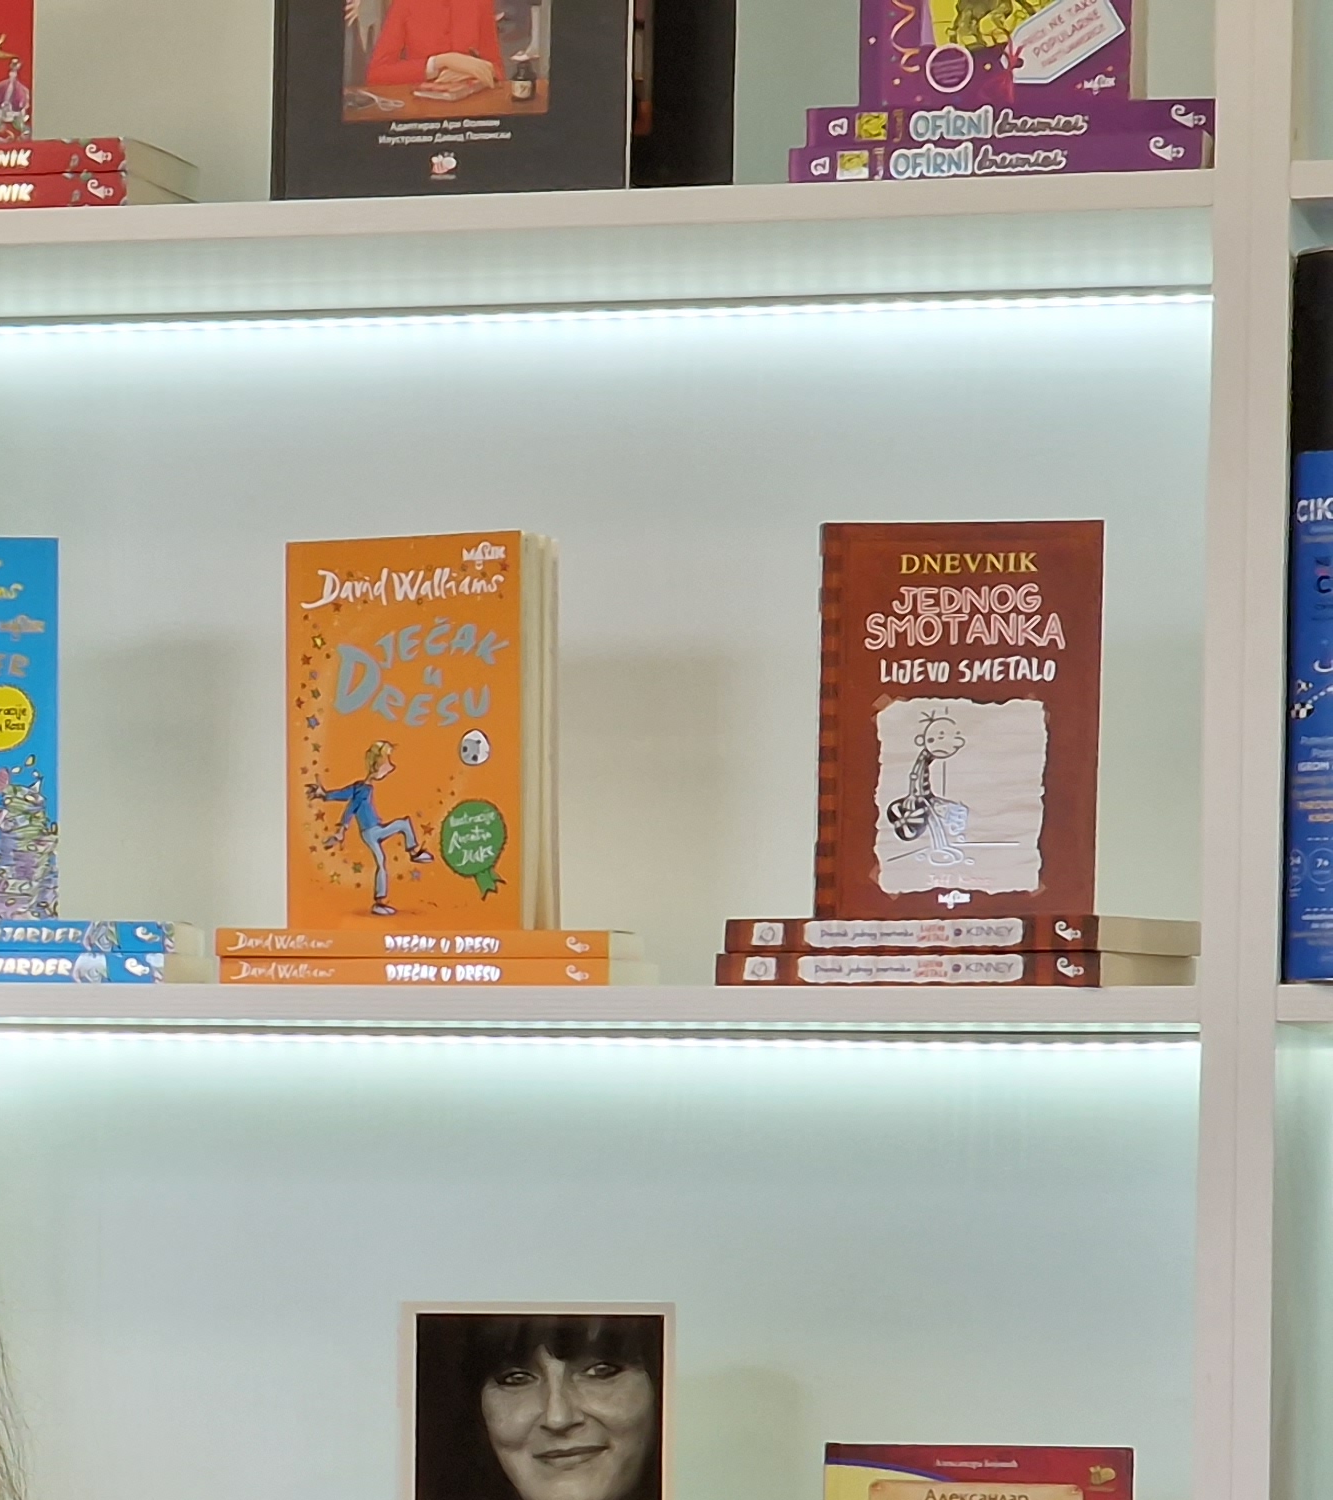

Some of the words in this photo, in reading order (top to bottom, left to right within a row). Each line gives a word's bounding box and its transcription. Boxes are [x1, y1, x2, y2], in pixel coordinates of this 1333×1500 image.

[900, 552, 1039, 575] DNEVNIK
[300, 567, 388, 609] David
[390, 567, 505, 602] Walliams
[892, 583, 1042, 615] JEDNOG
[864, 612, 1066, 650] SMOTANKA
[880, 659, 950, 684] LIJEVO
[958, 655, 1057, 683] SMETALO
[226, 931, 274, 951] David
[384, 935, 435, 953] DJEČAK
[440, 937, 451, 953] U
[454, 935, 500, 954] DRESU
[965, 925, 1014, 937] KINNEY
[229, 961, 276, 981] David
[385, 963, 437, 982] DJEČAK
[440, 966, 452, 982] U
[455, 963, 501, 982] DRESU
[964, 961, 1014, 974] KINNEY
